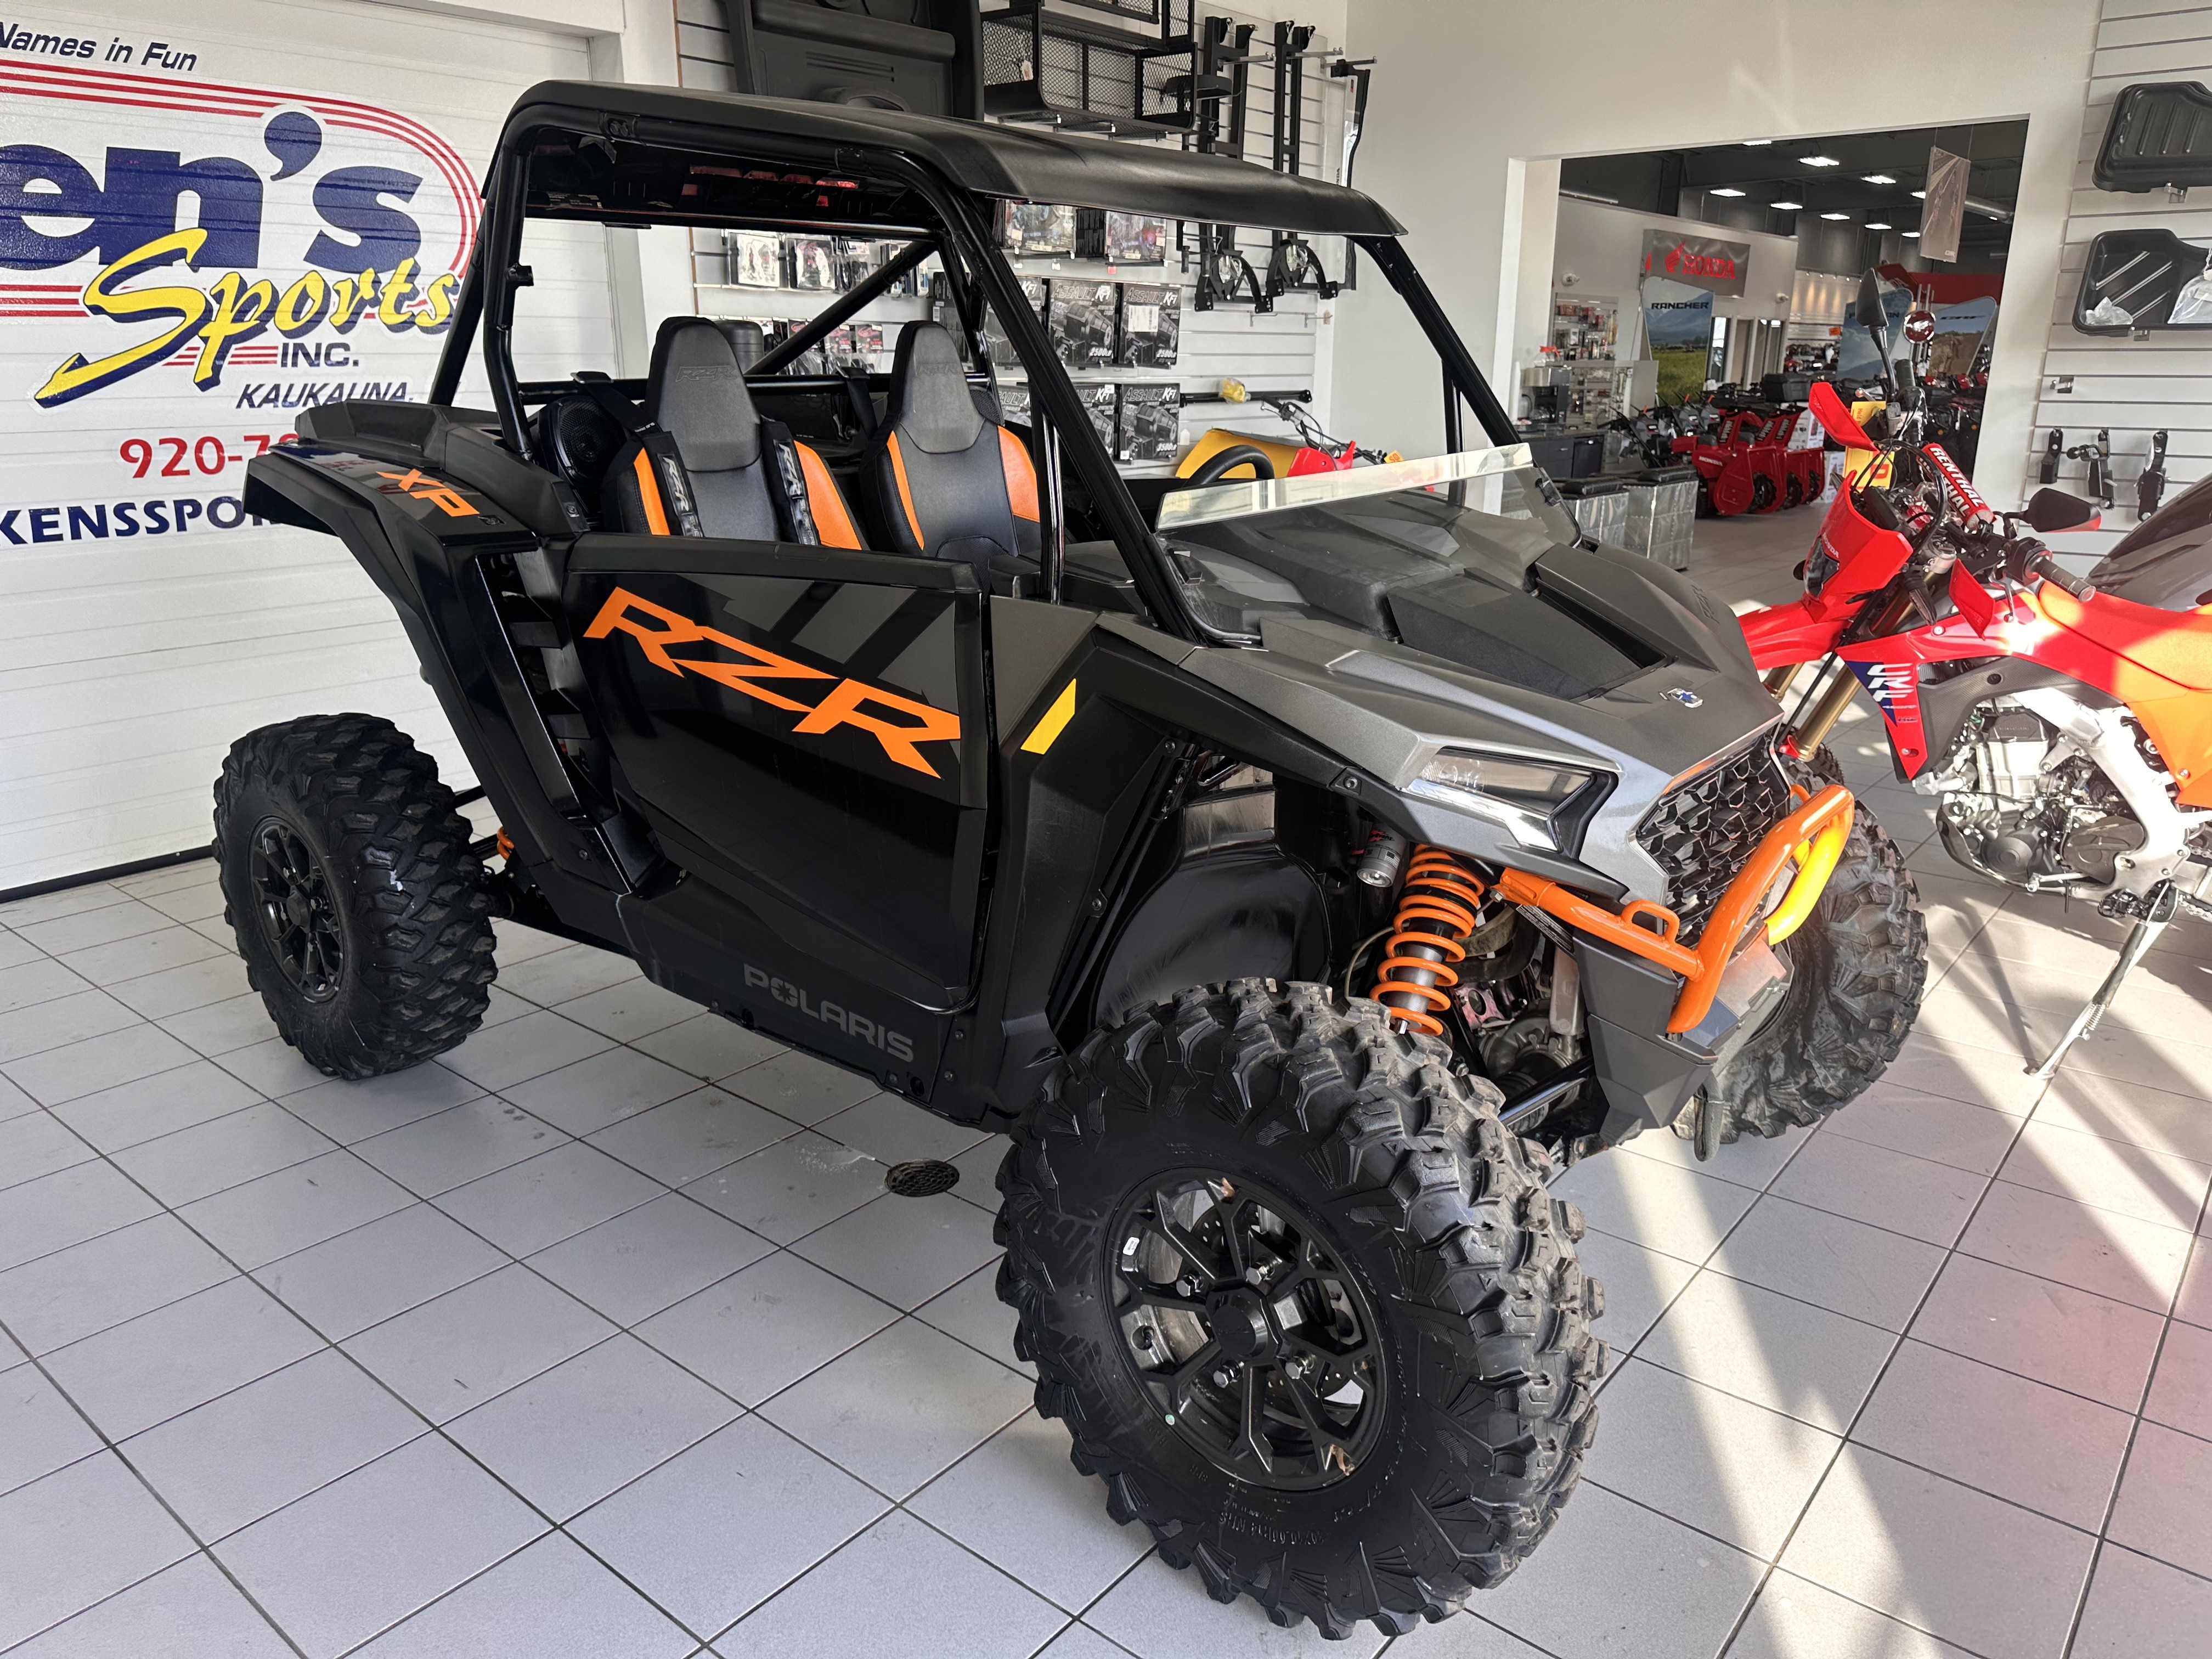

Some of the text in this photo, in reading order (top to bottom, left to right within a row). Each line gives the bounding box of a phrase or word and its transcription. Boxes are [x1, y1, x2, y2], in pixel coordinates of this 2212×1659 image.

[105, 37, 133, 63] in
[141, 42, 198, 72] Fun
[1682, 255, 1735, 280] HONDA
[1052, 283, 1097, 301] ASSAULT
[1124, 287, 1164, 303] ASSAULT
[34, 228, 461, 409] Sports
[281, 342, 359, 368] INC.
[675, 365, 737, 382] RZR
[1125, 387, 1164, 402] ASSAULT
[120, 432, 299, 478] 920-7
[778, 443, 801, 495] RZR
[376, 469, 480, 517] XP
[663, 456, 690, 512] RZR
[1929, 447, 1984, 507] RENTHAL
[583, 586, 961, 780] RZR
[1867, 662, 1915, 702] CRF
[743, 963, 914, 1063] POLARIS
